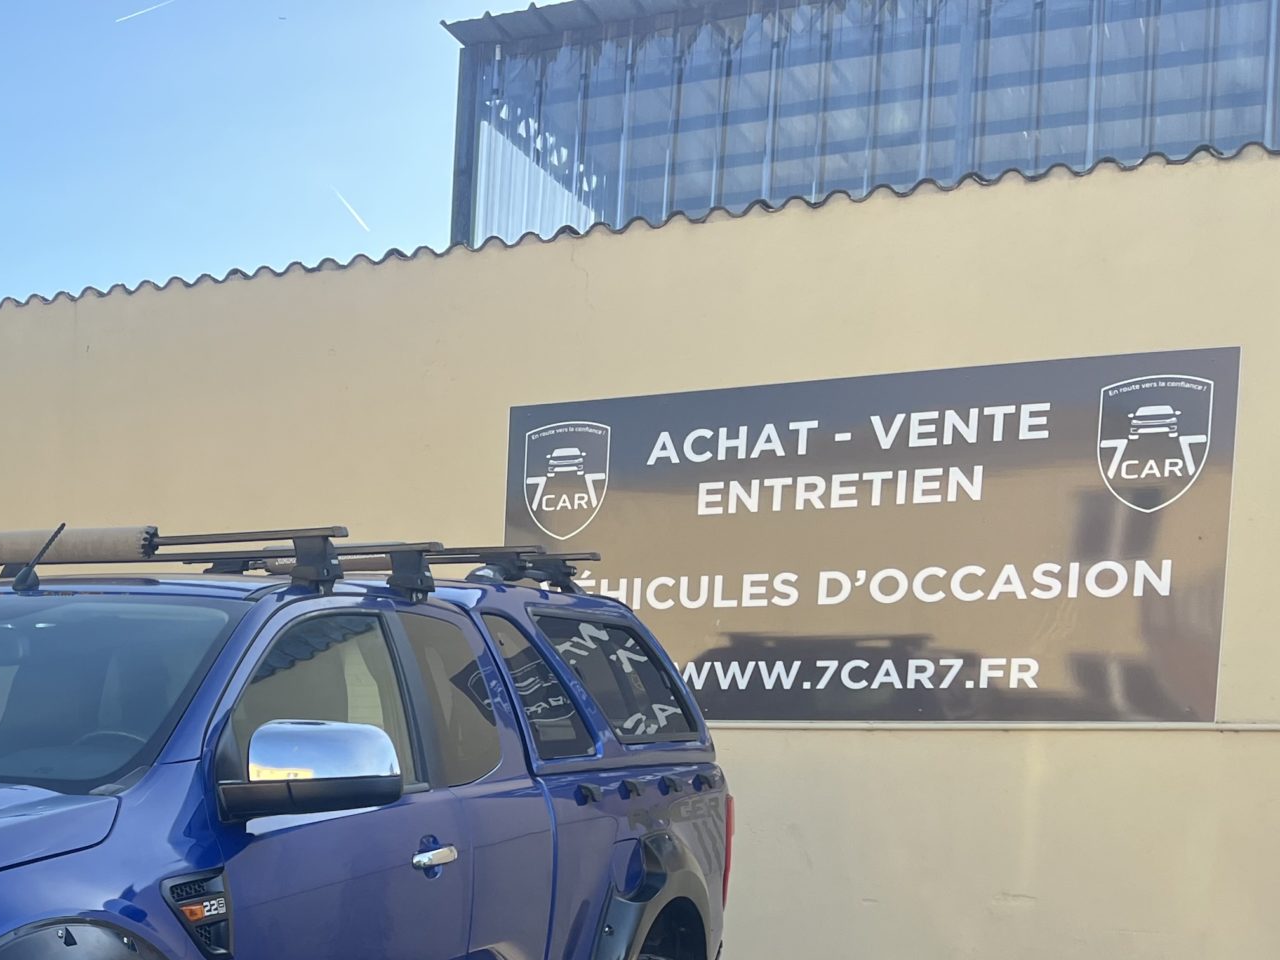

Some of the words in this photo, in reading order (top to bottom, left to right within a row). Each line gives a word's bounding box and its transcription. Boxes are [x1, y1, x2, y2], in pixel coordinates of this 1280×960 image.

[1120, 385, 1140, 393] route
[1167, 381, 1202, 391] confiance
[540, 430, 555, 438] route
[575, 426, 602, 435] confiance
[646, 420, 819, 465] ACHAT
[870, 402, 1051, 450] VENTE
[697, 465, 983, 515] ENTRETIEN
[540, 570, 799, 610] ÉHICULES
[817, 559, 1173, 606] D'OCCASION
[673, 657, 1040, 690] WWW.7CAR7.FR
